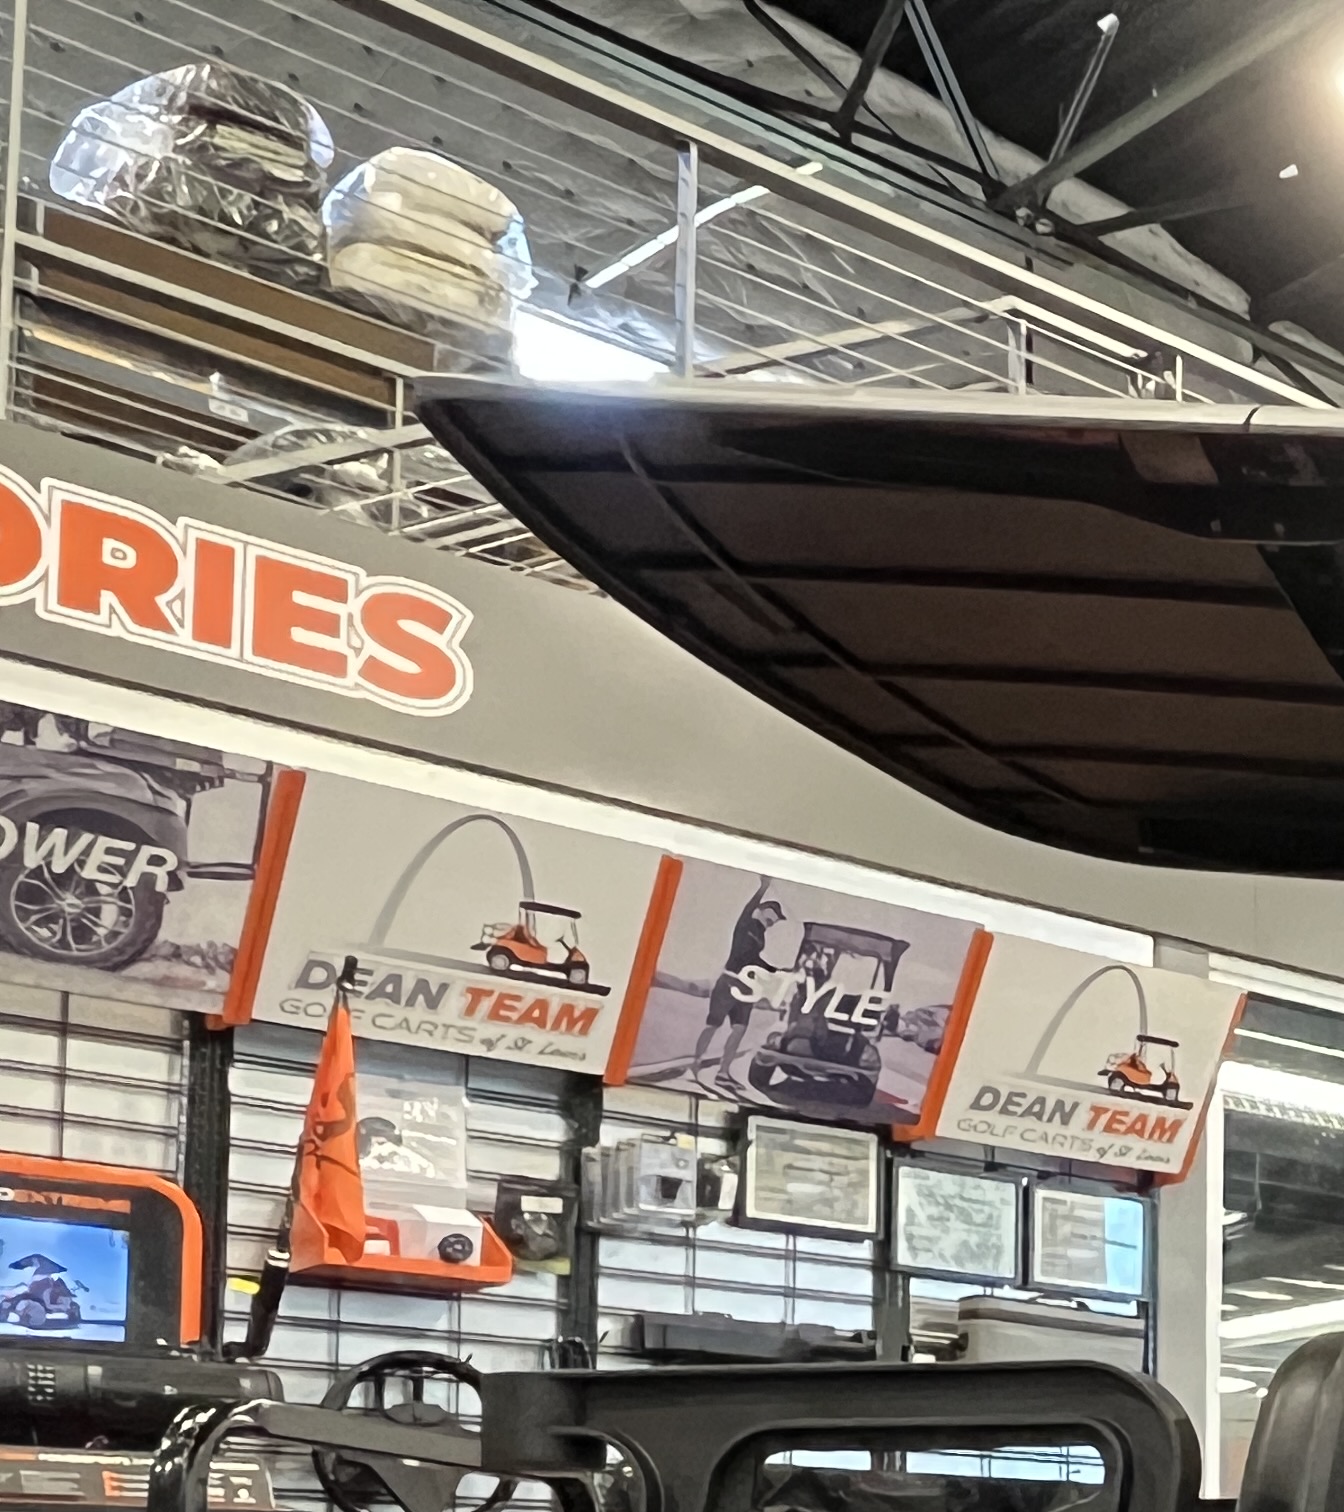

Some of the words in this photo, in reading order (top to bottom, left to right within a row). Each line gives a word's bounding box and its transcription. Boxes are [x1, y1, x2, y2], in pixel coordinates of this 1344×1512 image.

[278, 997, 366, 1023] GOF
[371, 1011, 477, 1044] CARTS
[295, 958, 450, 1011] DEAN
[463, 987, 602, 1037] TEAM
[731, 964, 893, 1026] STYLE
[956, 1118, 1018, 1138] GOLF
[1020, 1127, 1094, 1152] CARTS
[969, 1085, 1080, 1127] DEAN
[1085, 1104, 1188, 1145] TEAM
